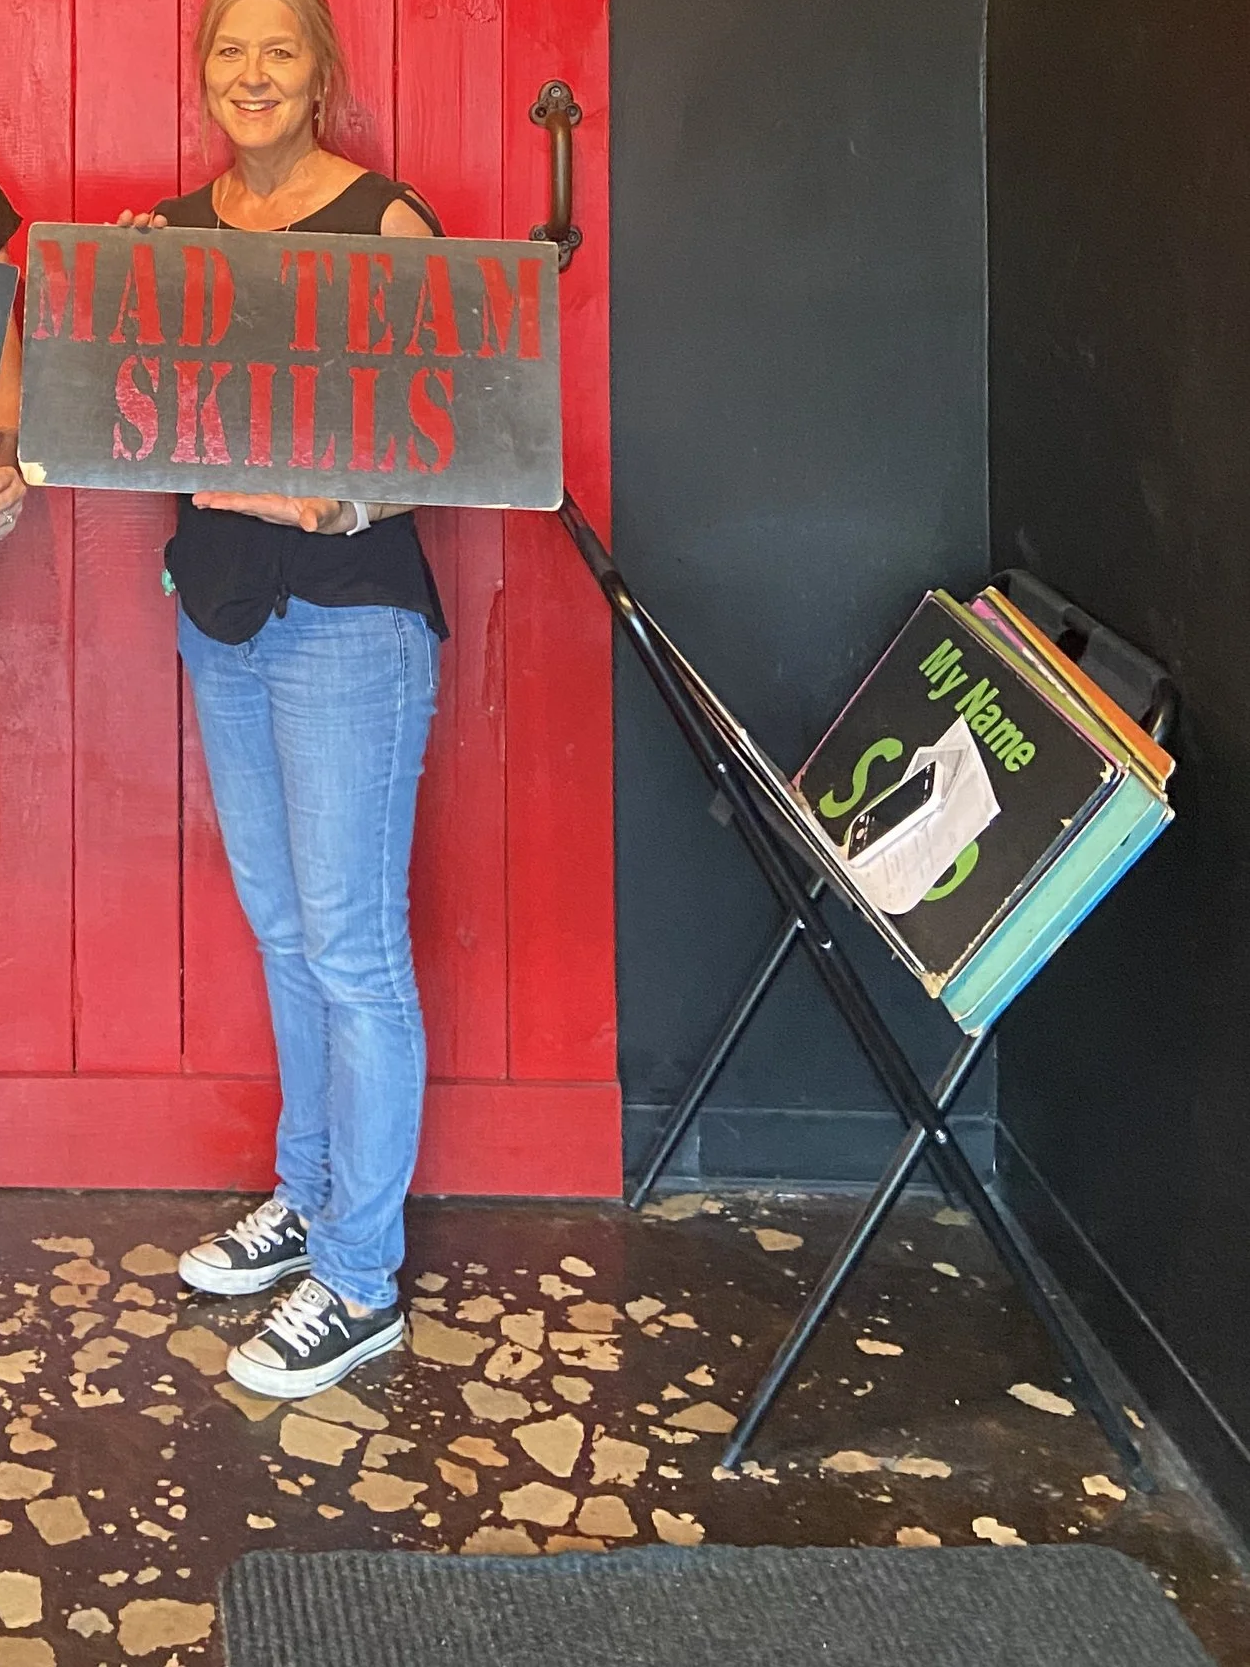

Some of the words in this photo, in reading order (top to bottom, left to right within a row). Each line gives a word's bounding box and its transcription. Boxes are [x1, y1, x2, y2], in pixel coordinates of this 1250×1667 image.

[30, 238, 236, 347] MAD
[280, 249, 544, 362] TEAM
[112, 354, 456, 474] SKILLS
[918, 638, 969, 702] My
[954, 677, 1037, 773] Name
